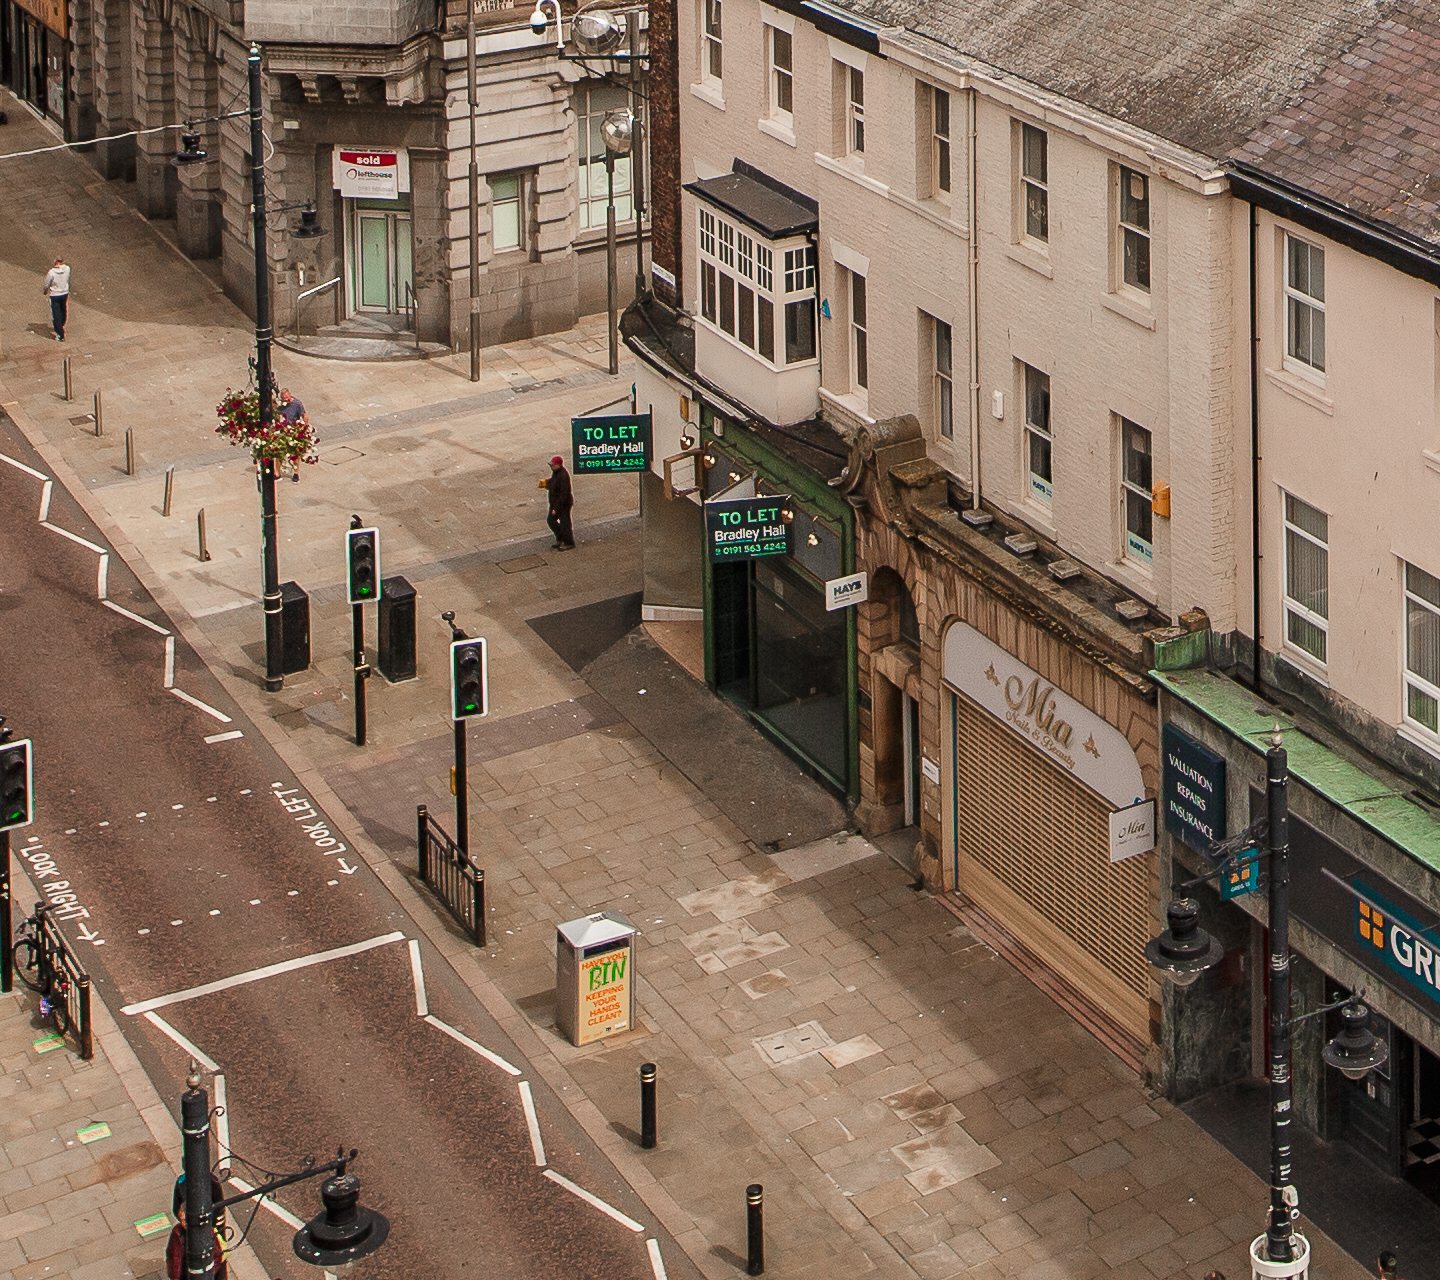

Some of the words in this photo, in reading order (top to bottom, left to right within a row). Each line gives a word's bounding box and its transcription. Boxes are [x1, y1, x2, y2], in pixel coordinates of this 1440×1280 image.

[356, 155, 381, 165] sold
[357, 170, 393, 179] lofthouse
[583, 427, 604, 441] TO
[609, 425, 639, 439] LET
[579, 443, 620, 458] Bradley
[623, 441, 644, 454] Hall
[586, 460, 604, 468] 0191
[605, 459, 622, 467] 563
[623, 458, 645, 466] 4242
[719, 511, 742, 526] TO
[747, 507, 779, 523] LET
[714, 527, 760, 542] Bradley
[763, 524, 786, 537] Hall
[723, 546, 742, 555] 0191
[744, 544, 761, 553] 563
[763, 542, 787, 551] 4242
[833, 580, 862, 597] HAYS
[1004, 674, 1073, 750] Mia
[1005, 710, 1031, 734] Nails
[1031, 729, 1041, 741] &
[1041, 735, 1076, 770] Beauty
[1169, 753, 1213, 793] VALUATION
[273, 788, 318, 822] LEFT
[1177, 781, 1207, 812] REPAIRS
[1118, 820, 1145, 839] Mia
[1170, 799, 1214, 841] INSURANCE
[302, 821, 347, 856] LOOK
[20, 844, 60, 879] LOOK
[42, 880, 91, 921] RIGHT
[581, 957, 605, 971] HAVE
[606, 951, 625, 964] YOU
[589, 956, 627, 991] BIN
[585, 984, 625, 1002] KEEPING
[592, 995, 617, 1007] YOUR
[589, 1002, 621, 1017] HANDS
